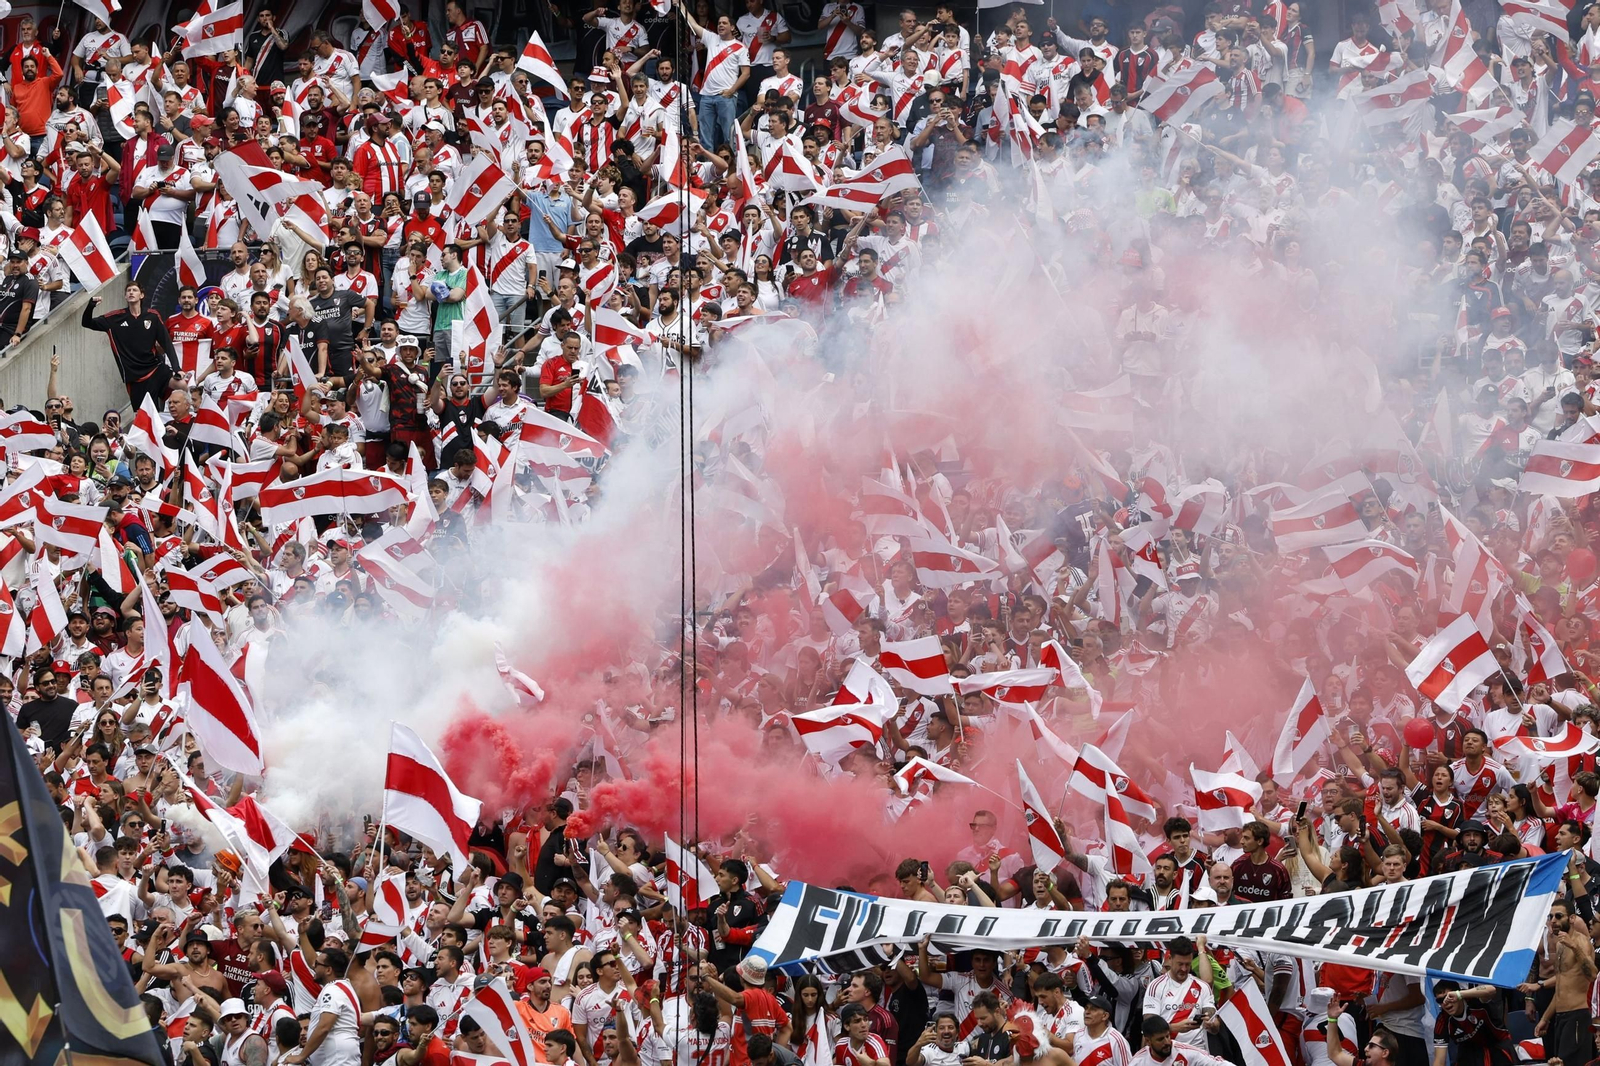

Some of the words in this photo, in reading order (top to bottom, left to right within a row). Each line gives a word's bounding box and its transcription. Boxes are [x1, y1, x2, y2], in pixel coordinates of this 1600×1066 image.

[644, 16, 669, 24] codere
[316, 307, 341, 317] TURKISH
[1238, 885, 1271, 897] codere
[236, 954, 247, 963] 25
[1164, 1001, 1201, 1011] codere
